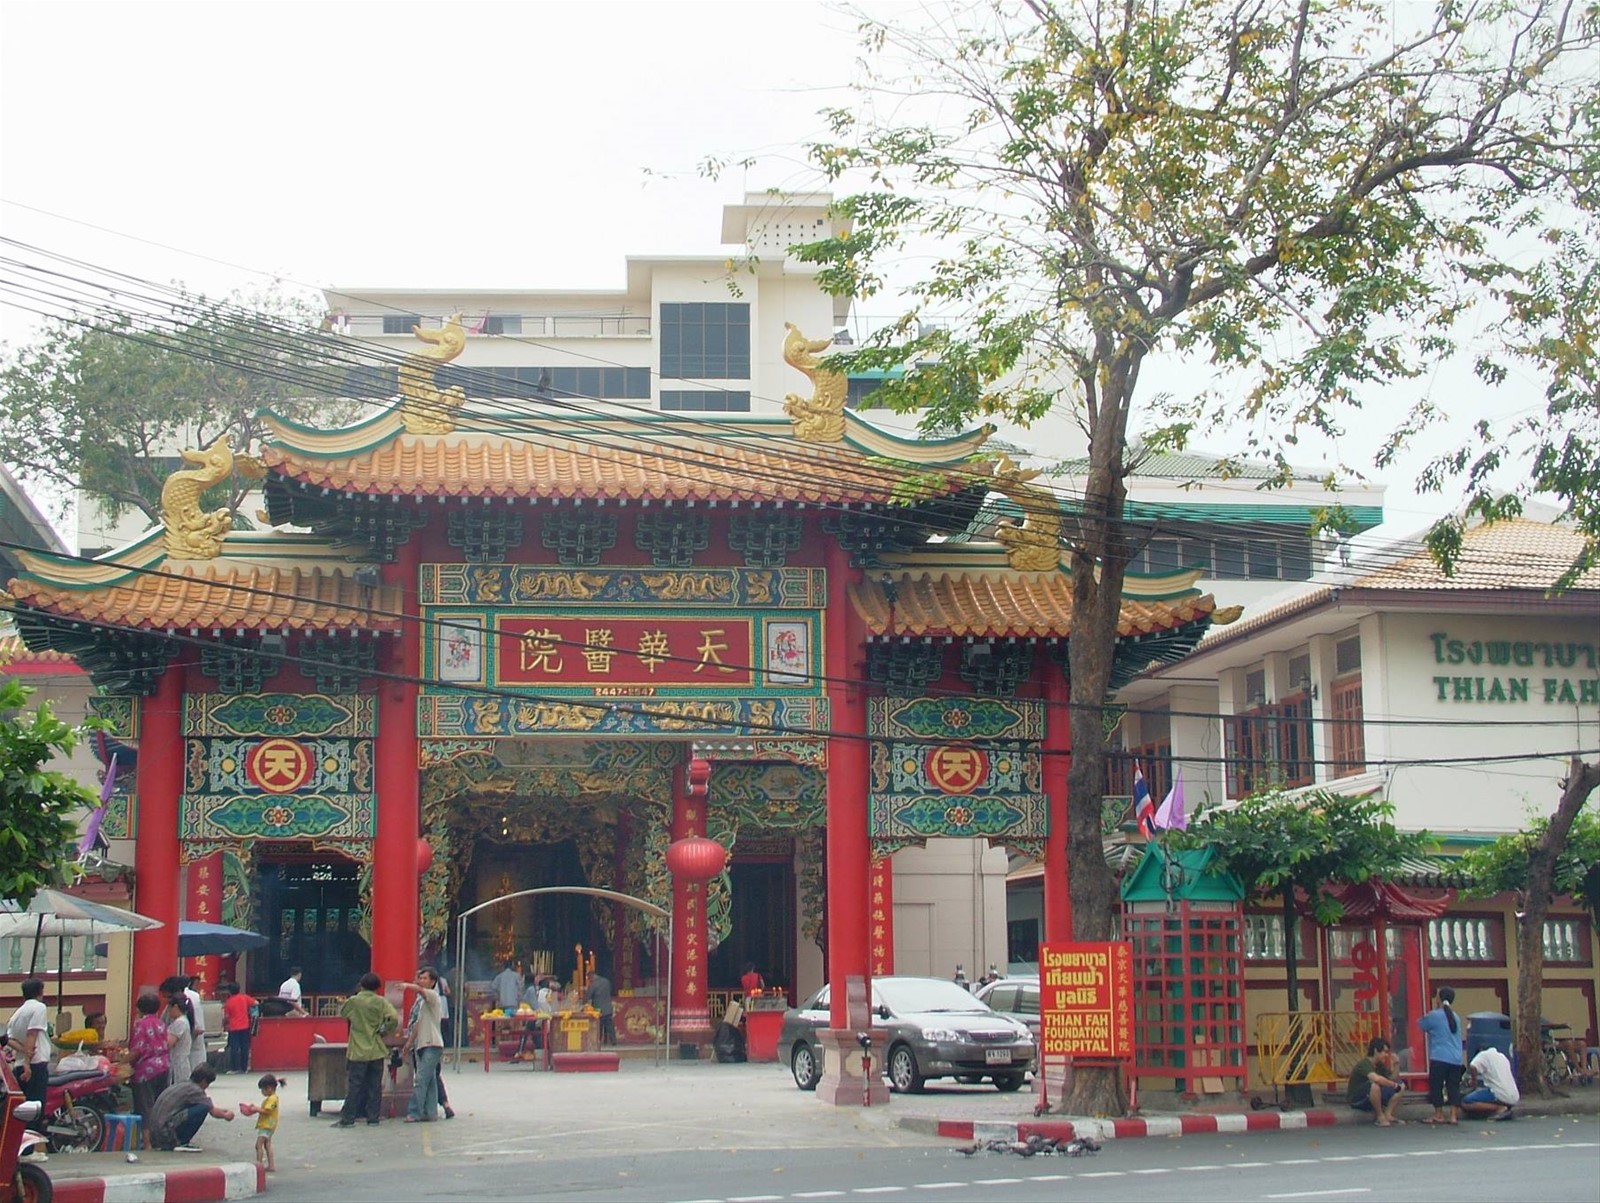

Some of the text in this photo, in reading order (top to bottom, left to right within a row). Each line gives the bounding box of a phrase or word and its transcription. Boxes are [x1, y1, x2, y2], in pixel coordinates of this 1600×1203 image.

[1430, 632, 1600, 670] โรงพยาบา
[1433, 676, 1600, 704] THIAN FAH
[1043, 947, 1107, 967] โรงพยาบาล
[1044, 1014, 1108, 1026] THIAN FAH
[1044, 1027, 1108, 1038] FOUNDATION
[1044, 1040, 1109, 1052] HOSPITAL
